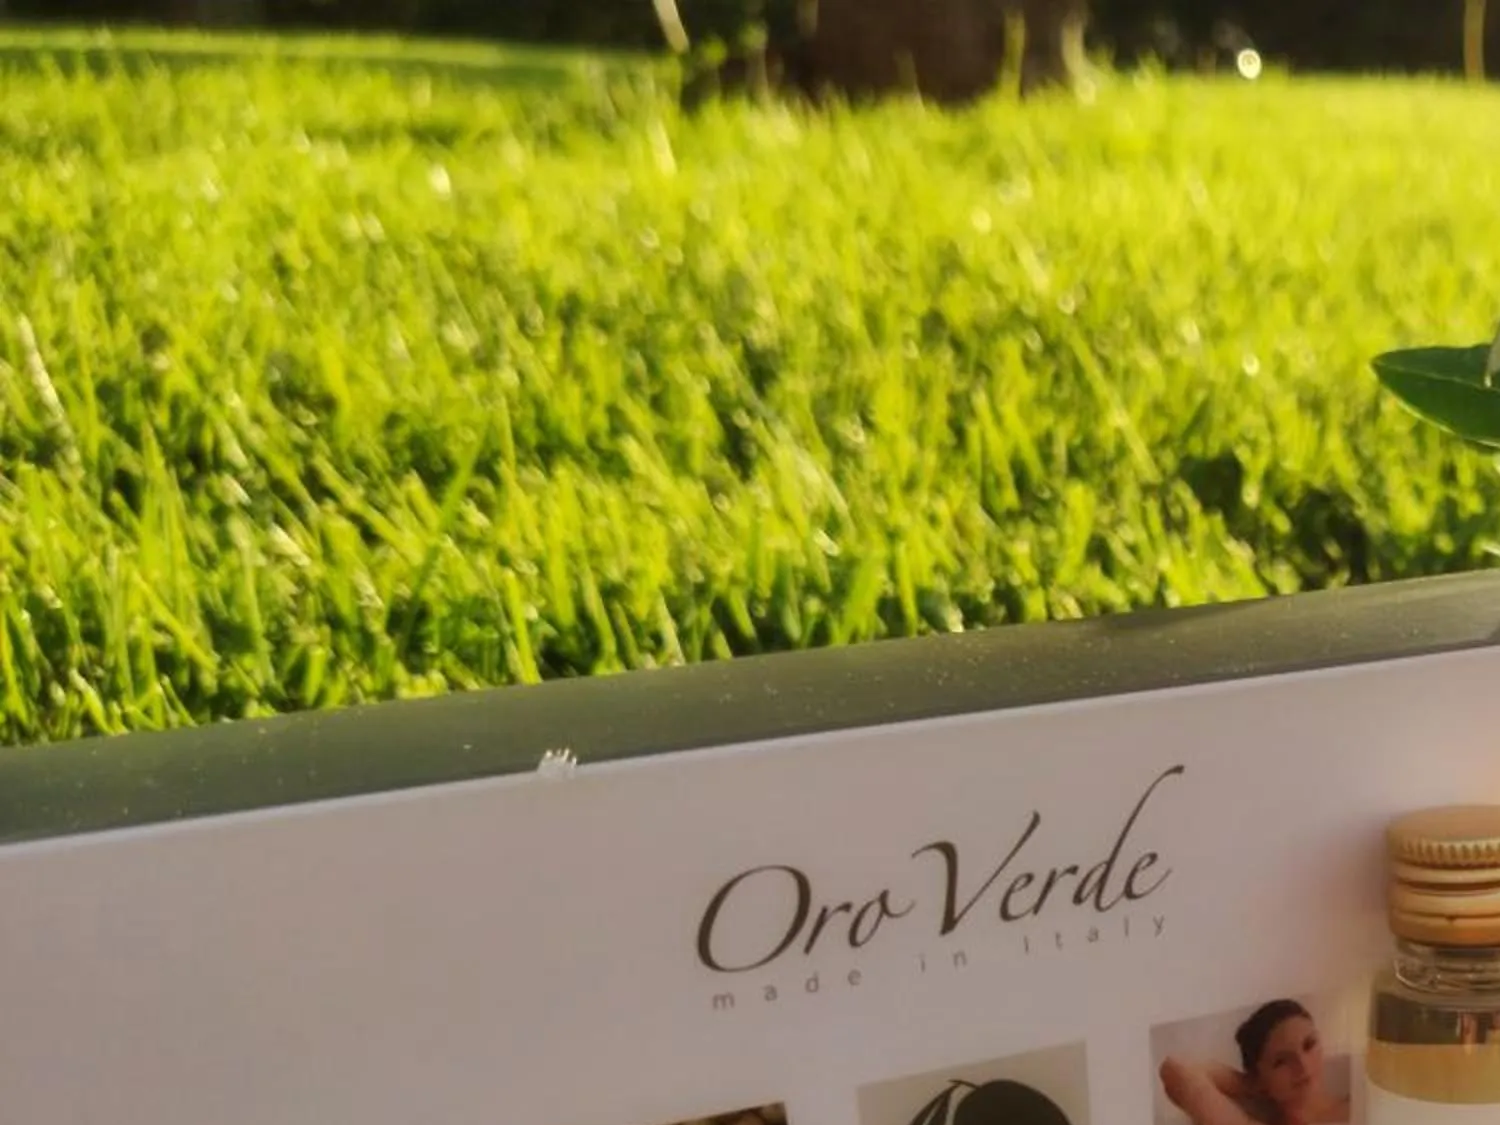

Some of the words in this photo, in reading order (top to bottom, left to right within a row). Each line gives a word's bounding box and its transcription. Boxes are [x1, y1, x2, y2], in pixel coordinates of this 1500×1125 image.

[696, 864, 915, 973] Oro
[911, 764, 1185, 936] Verde
[711, 965, 862, 1011] made
[918, 948, 968, 973] in
[1022, 913, 1165, 954] Italy
